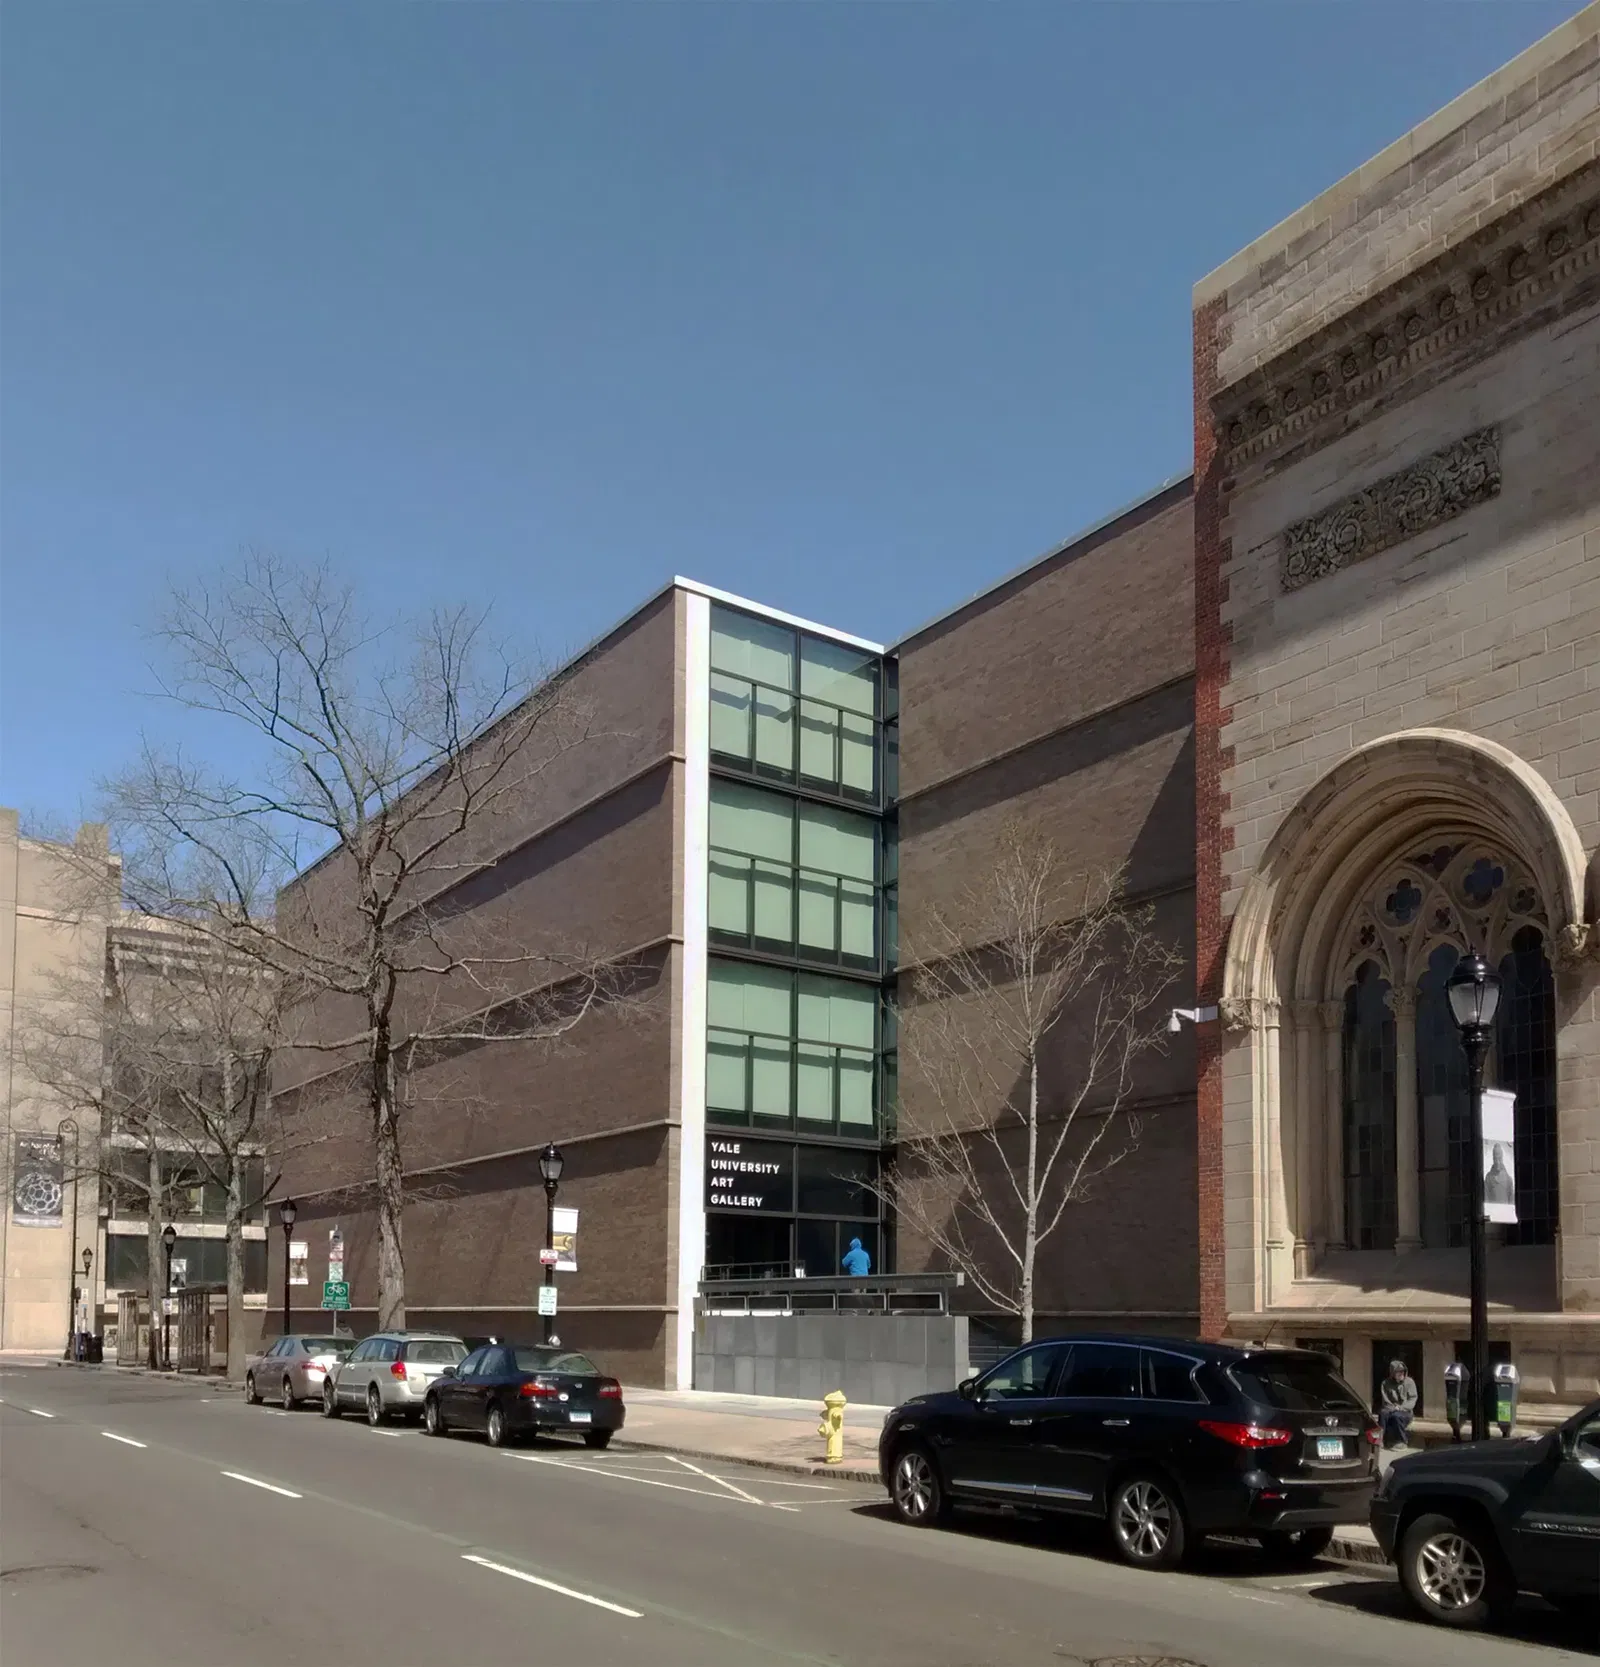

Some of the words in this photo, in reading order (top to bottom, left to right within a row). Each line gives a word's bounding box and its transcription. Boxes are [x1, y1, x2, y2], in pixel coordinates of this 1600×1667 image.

[711, 1142, 740, 1154] YALE
[711, 1159, 780, 1175] UNIVERSITY
[711, 1177, 734, 1188] ART
[711, 1194, 763, 1207] GALLERY
